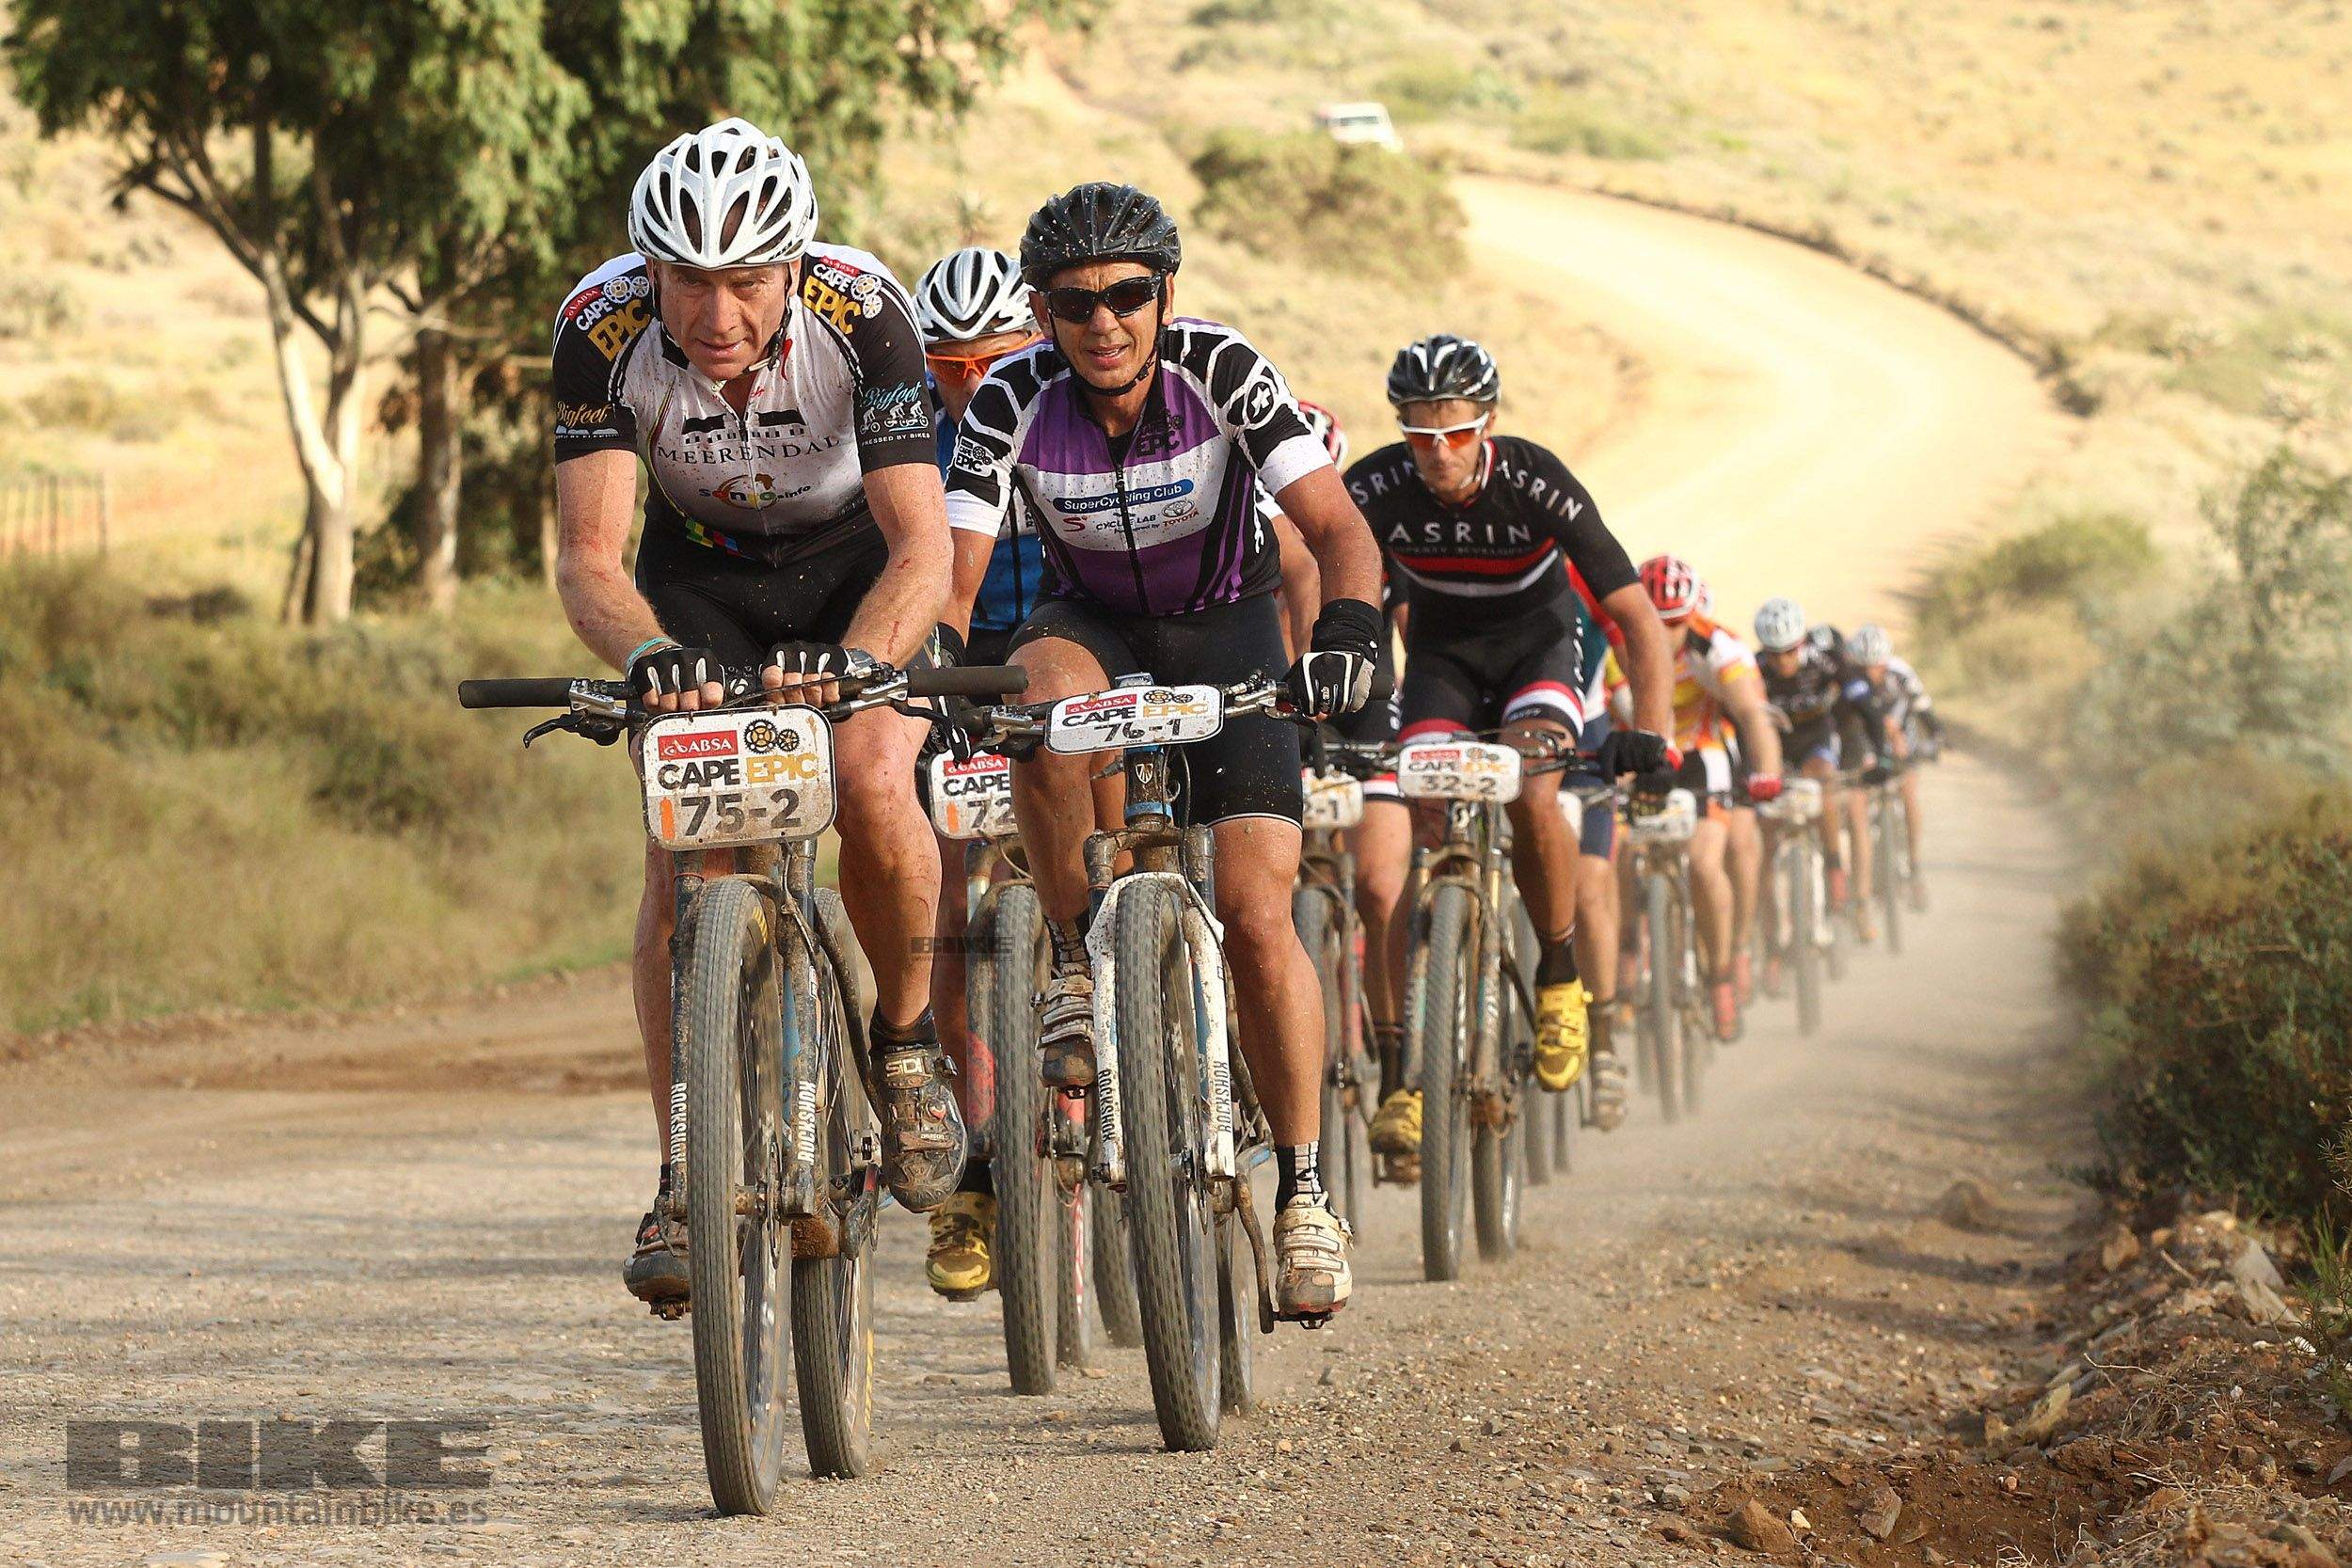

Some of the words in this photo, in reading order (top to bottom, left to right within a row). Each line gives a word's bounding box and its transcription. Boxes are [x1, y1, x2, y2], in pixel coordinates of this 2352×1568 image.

[813, 263, 852, 293] CAPE
[576, 297, 613, 331] CAPE
[803, 275, 862, 335] EPIC
[587, 299, 651, 362] EPIC
[657, 436, 840, 465] MEERENDAL
[956, 452, 983, 473] EPIC
[1153, 483, 1183, 499] Club
[1496, 459, 1585, 522] ASRIN
[1136, 515, 1156, 524] LAB
[1163, 510, 1200, 528] TOYOTA
[1389, 521, 1532, 545] ASRIN
[1062, 706, 1136, 727] CAPE
[1143, 704, 1208, 718] EPIC
[688, 737, 733, 752] ABSA
[1094, 719, 1182, 742] 76-1
[658, 758, 740, 790] CAPE
[746, 752, 819, 784] EPIC
[970, 757, 1004, 771] ABSA
[943, 773, 1011, 797] CAPE
[1422, 774, 1497, 795] 32-2
[681, 788, 801, 836] 75-2
[1099, 1069, 1116, 1143] ROCKSHOX
[1214, 1061, 1232, 1133] ROCKSHOX
[671, 1082, 688, 1165] ROCKSHOX
[797, 1080, 818, 1166] ROCKSHOX
